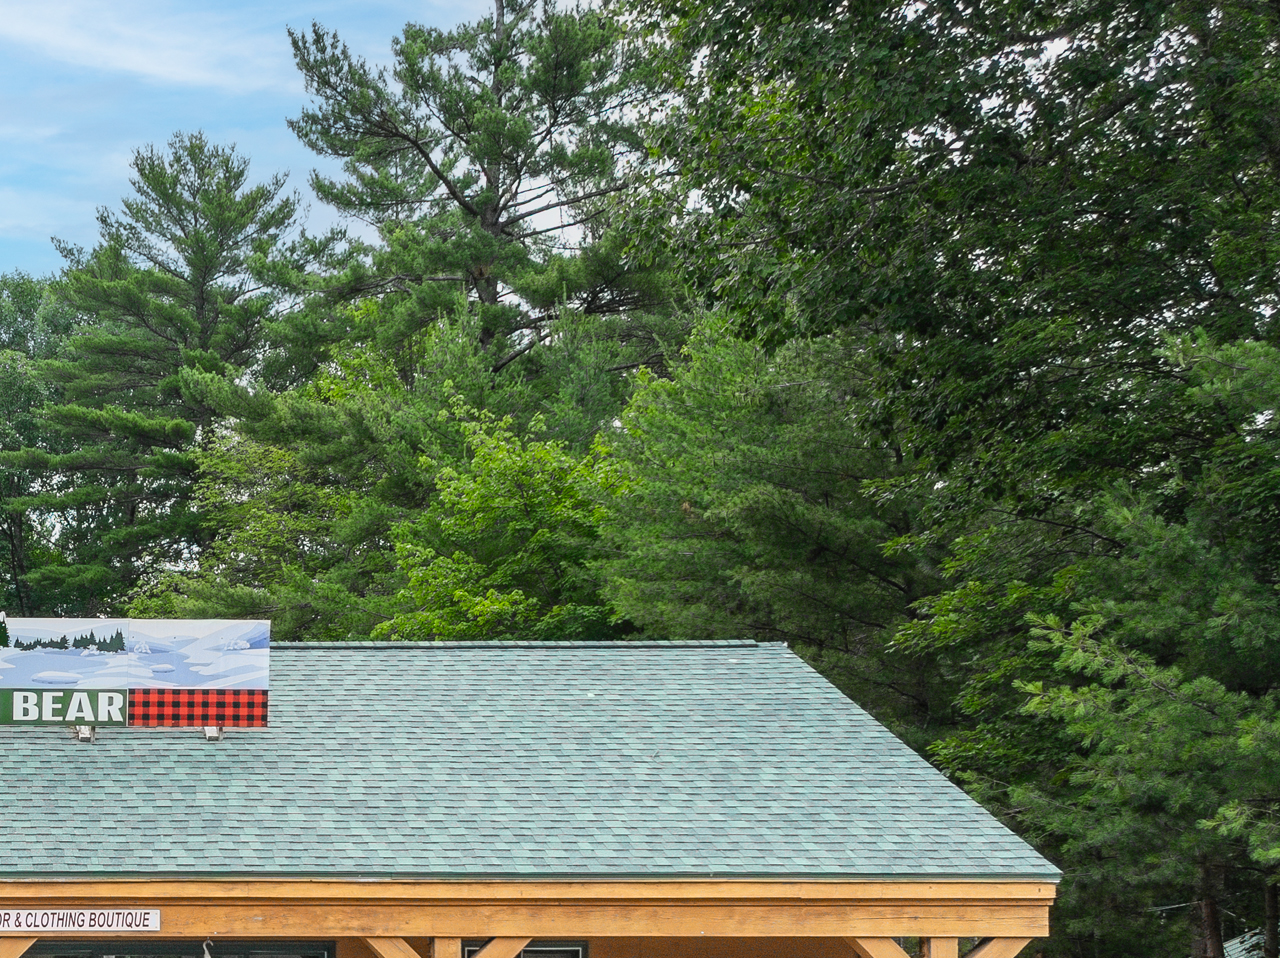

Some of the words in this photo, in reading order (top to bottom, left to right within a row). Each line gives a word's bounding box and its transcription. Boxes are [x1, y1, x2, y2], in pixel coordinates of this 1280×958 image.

[12, 691, 124, 722] BEAR
[14, 913, 22, 928] &
[25, 912, 86, 928] CLOTHING
[88, 912, 150, 928] BOUTIQUE
